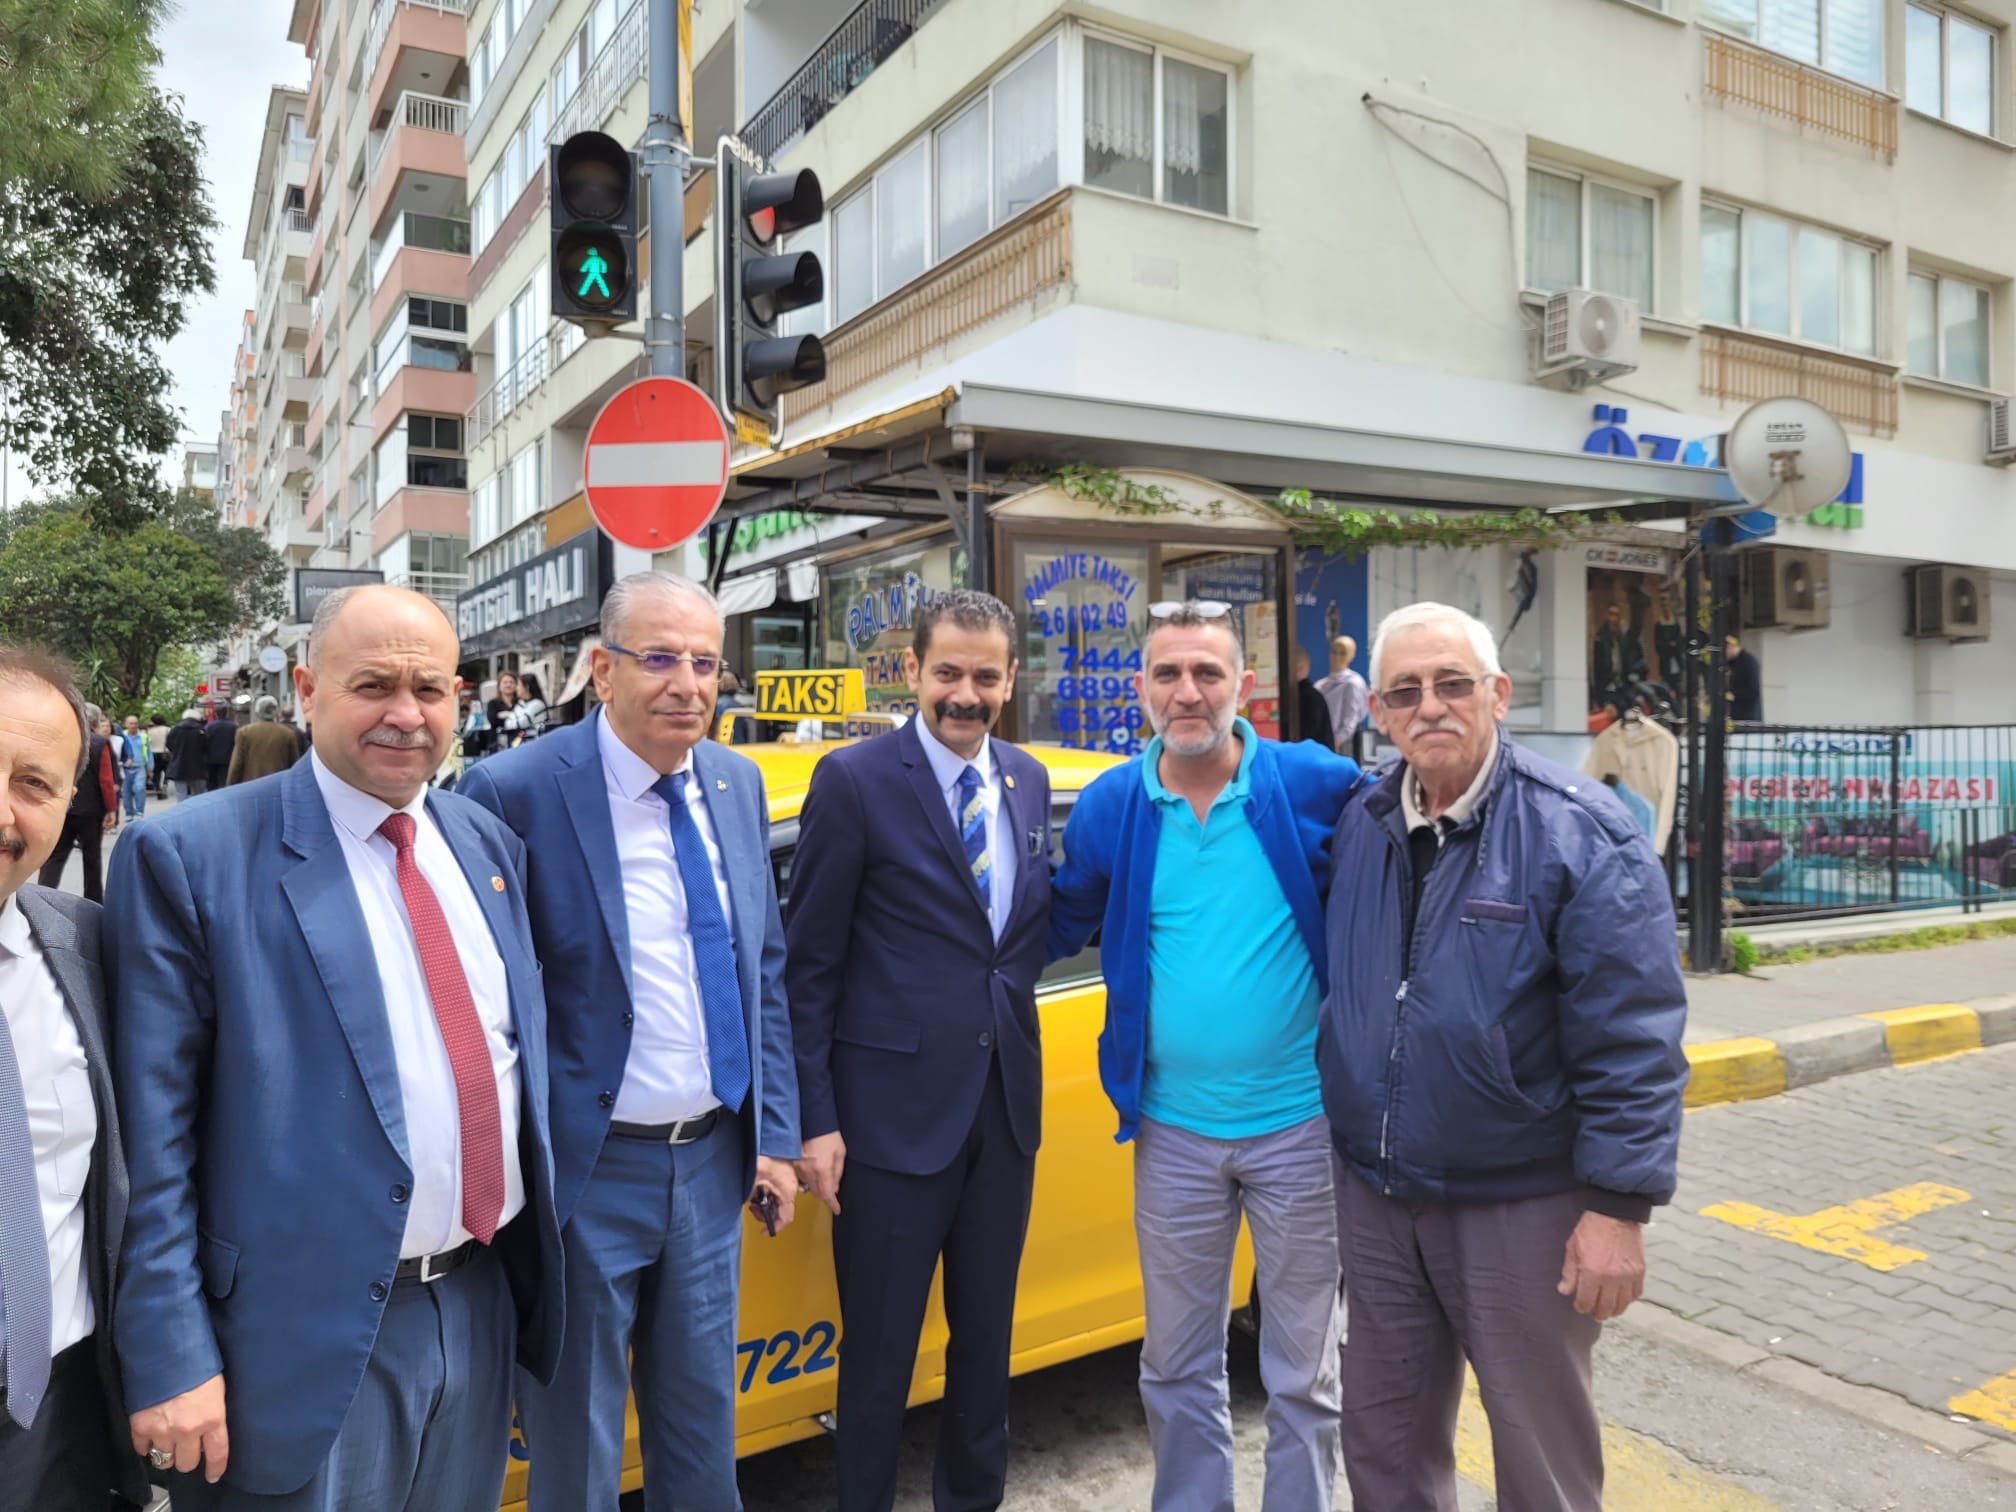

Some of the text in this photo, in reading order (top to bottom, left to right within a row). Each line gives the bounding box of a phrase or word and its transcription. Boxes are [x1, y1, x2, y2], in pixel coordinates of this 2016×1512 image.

[1080, 603, 1101, 633] 02
[1106, 601, 1127, 629] 49
[1058, 647, 1142, 673] 7444
[757, 676, 843, 714] TAKSİ
[736, 1320, 842, 1393] 722
